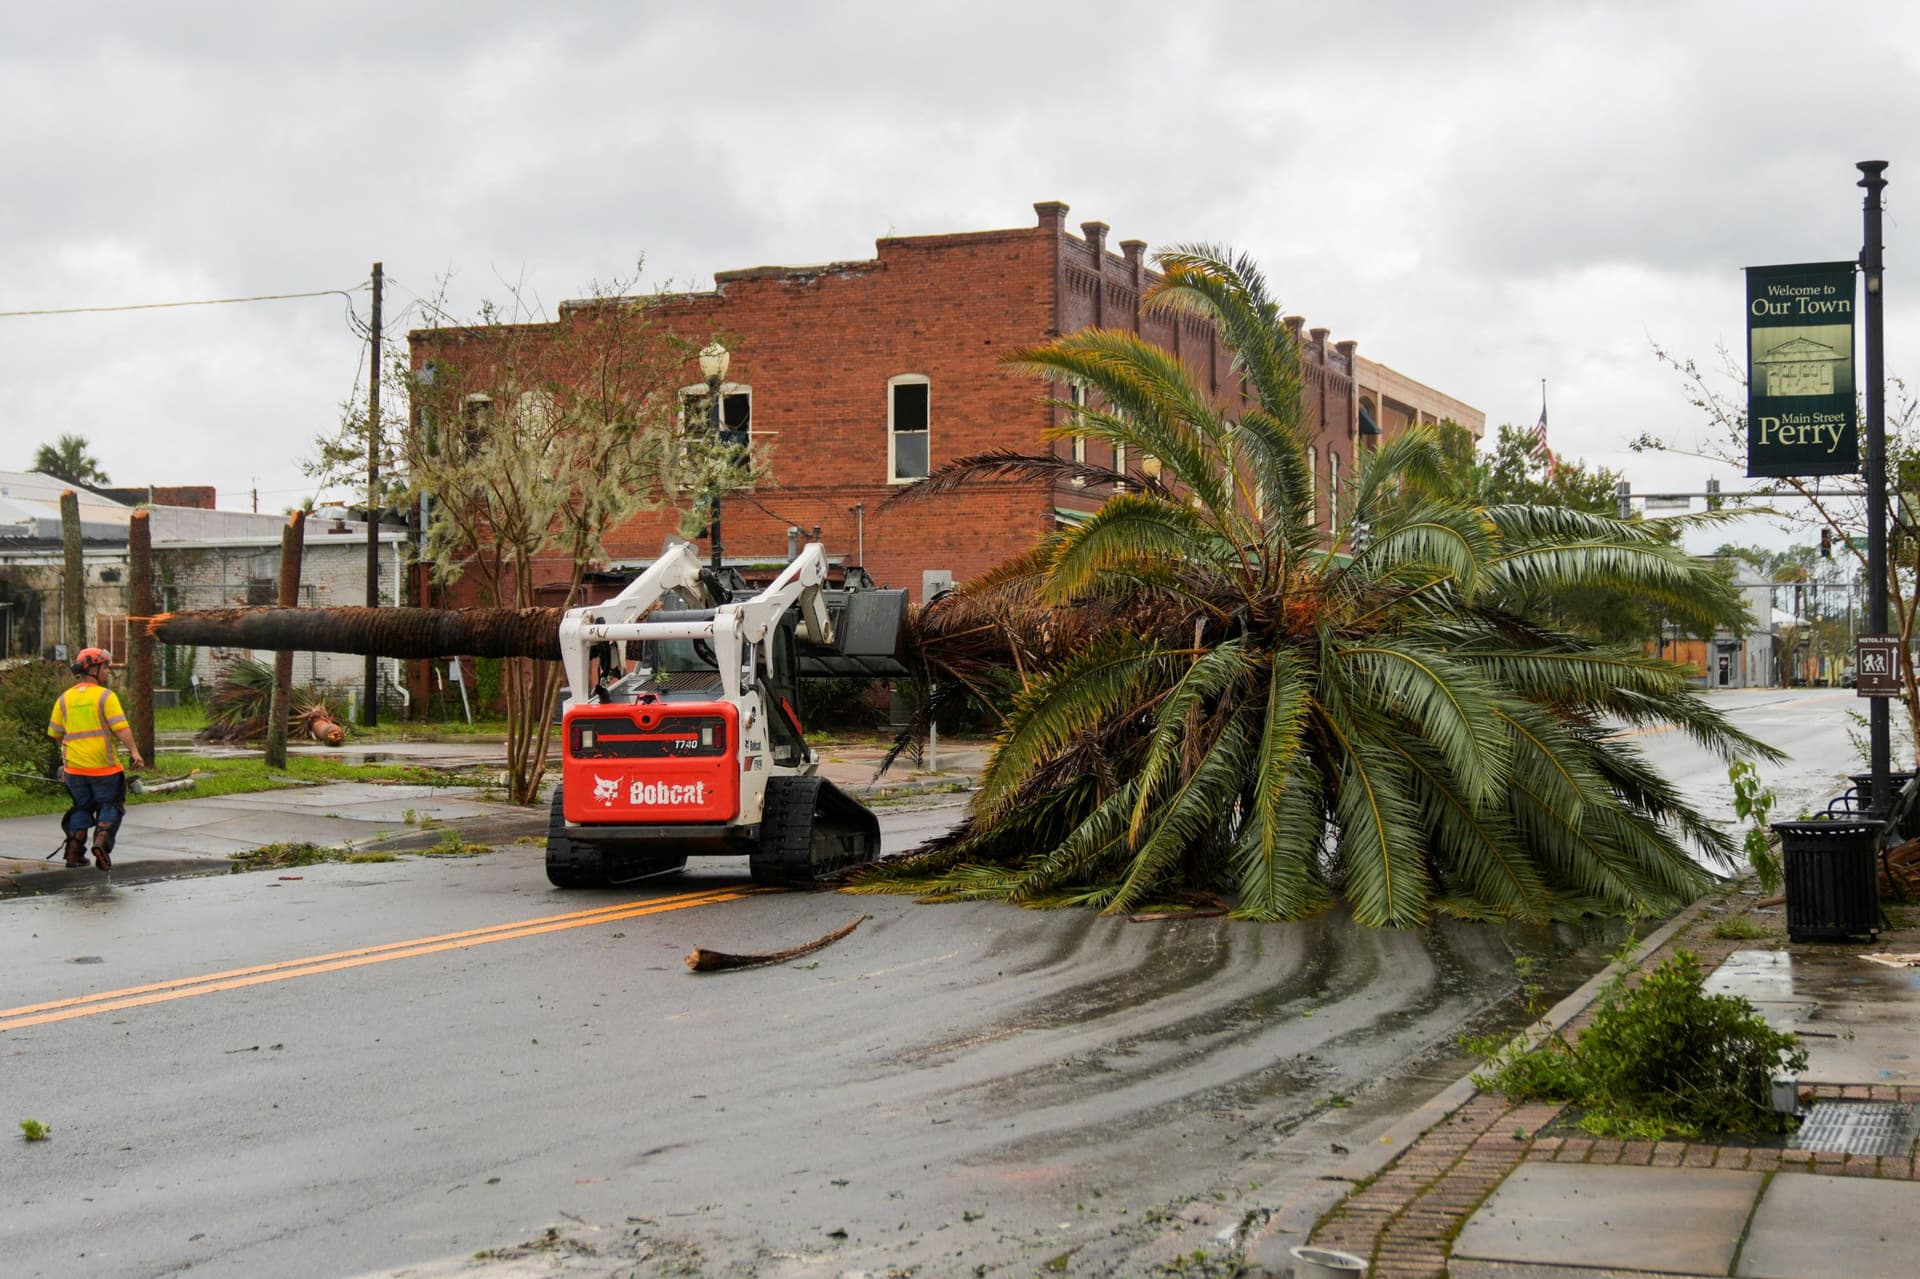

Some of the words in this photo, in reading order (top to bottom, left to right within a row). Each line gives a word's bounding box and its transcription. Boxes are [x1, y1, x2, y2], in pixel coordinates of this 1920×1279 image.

[1768, 284, 1821, 296] Welcome
[1823, 284, 1836, 295] to
[1751, 298, 1792, 316] Our
[1795, 296, 1852, 314] Town
[1781, 413, 1811, 424] Main
[1812, 411, 1845, 423] Street
[1758, 416, 1847, 454] Perry
[1872, 677, 1879, 685] 2
[674, 740, 698, 749] T740
[630, 781, 704, 805] Bobcat
